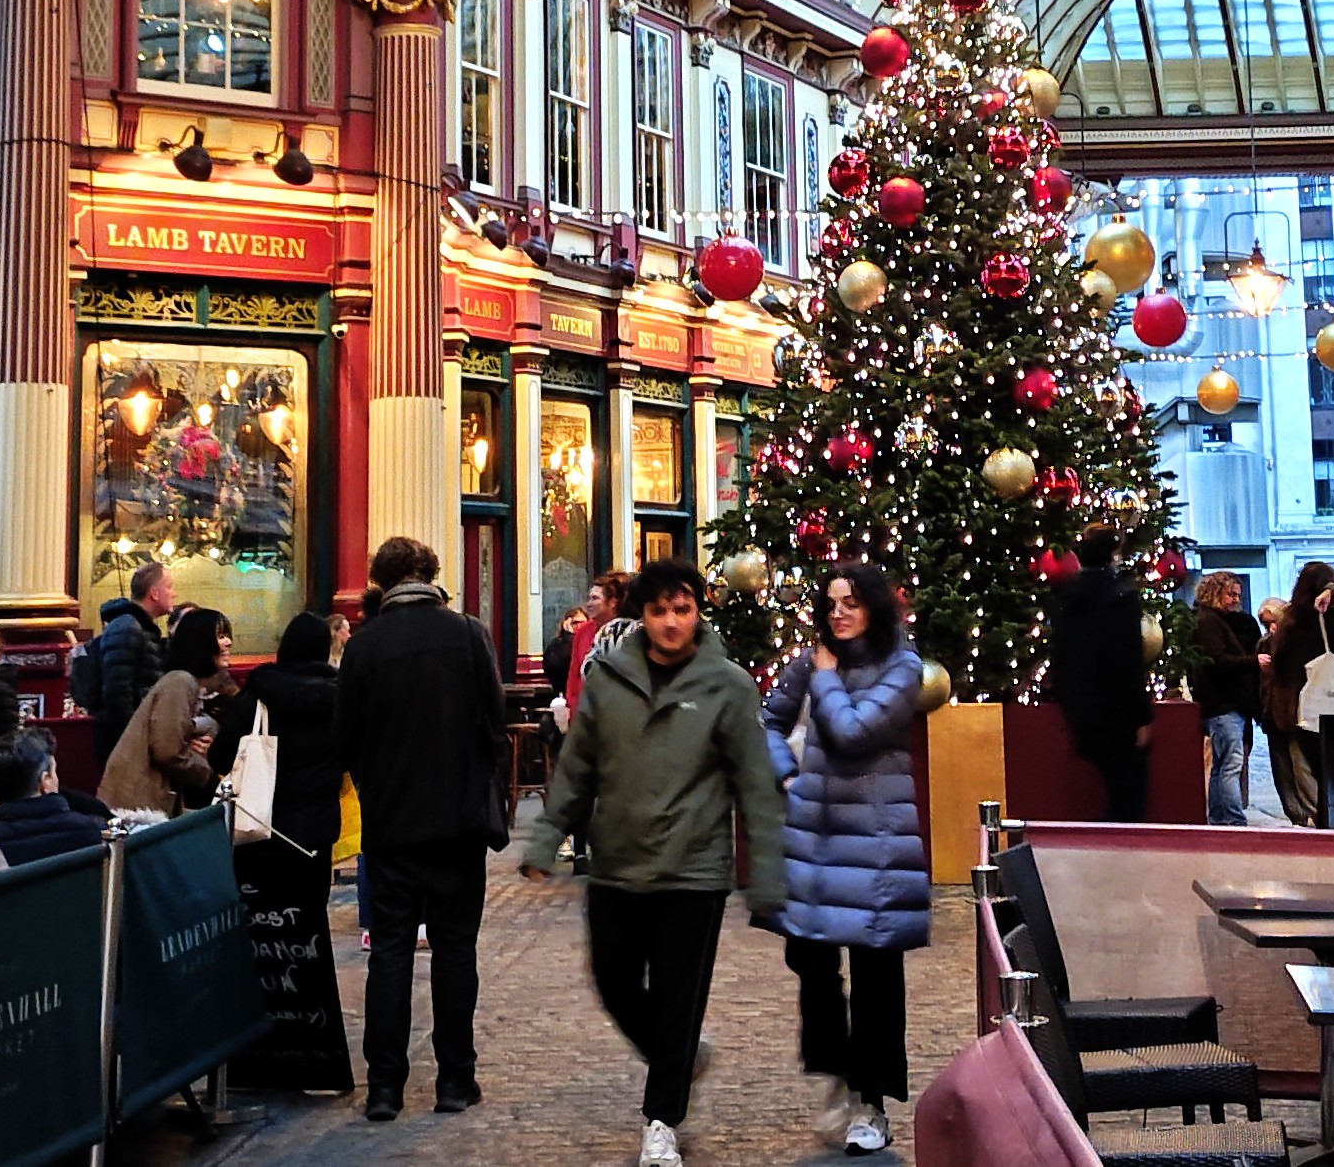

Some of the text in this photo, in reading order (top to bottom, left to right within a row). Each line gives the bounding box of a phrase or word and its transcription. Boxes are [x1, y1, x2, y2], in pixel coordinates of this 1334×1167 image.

[108, 224, 306, 259] LAMB TAVERN
[464, 297, 502, 321] LAMB
[550, 313, 593, 338] TAVERN
